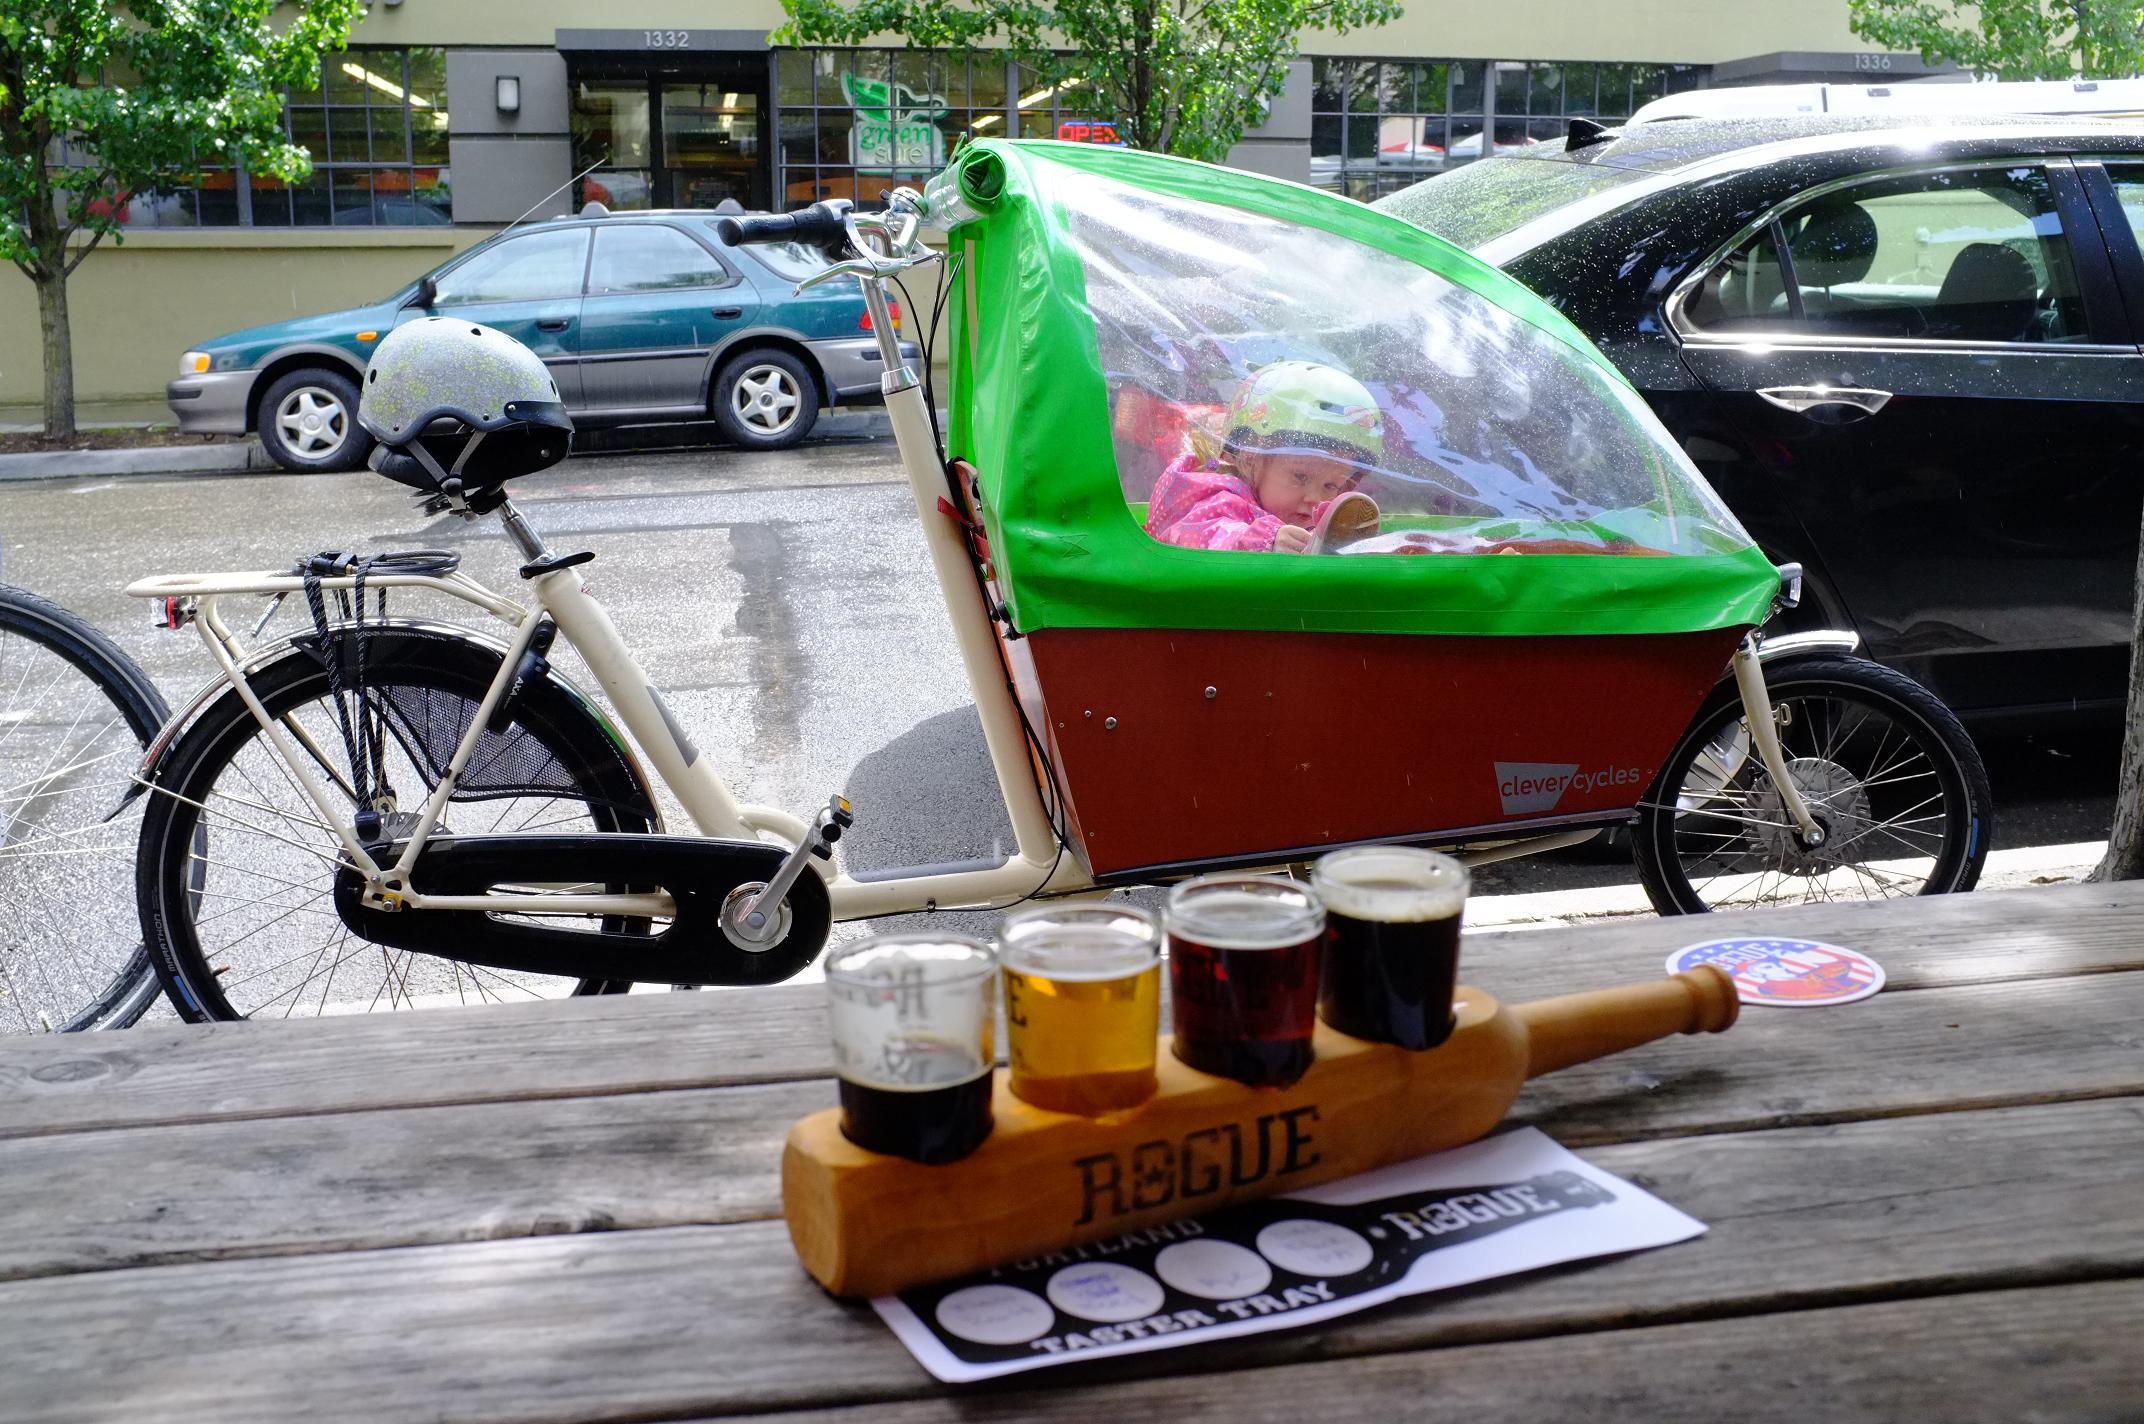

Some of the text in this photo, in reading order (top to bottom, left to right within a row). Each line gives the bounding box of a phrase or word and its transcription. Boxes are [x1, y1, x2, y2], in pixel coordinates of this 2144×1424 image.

[643, 31, 689, 47] 1332
[1854, 54, 1891, 70] 1336
[1073, 1105, 1321, 1226] ROGUE
[1380, 1184, 1561, 1240] ROGUE
[1030, 1308, 1217, 1353] TASTER
[1217, 1280, 1336, 1318] TRAY
